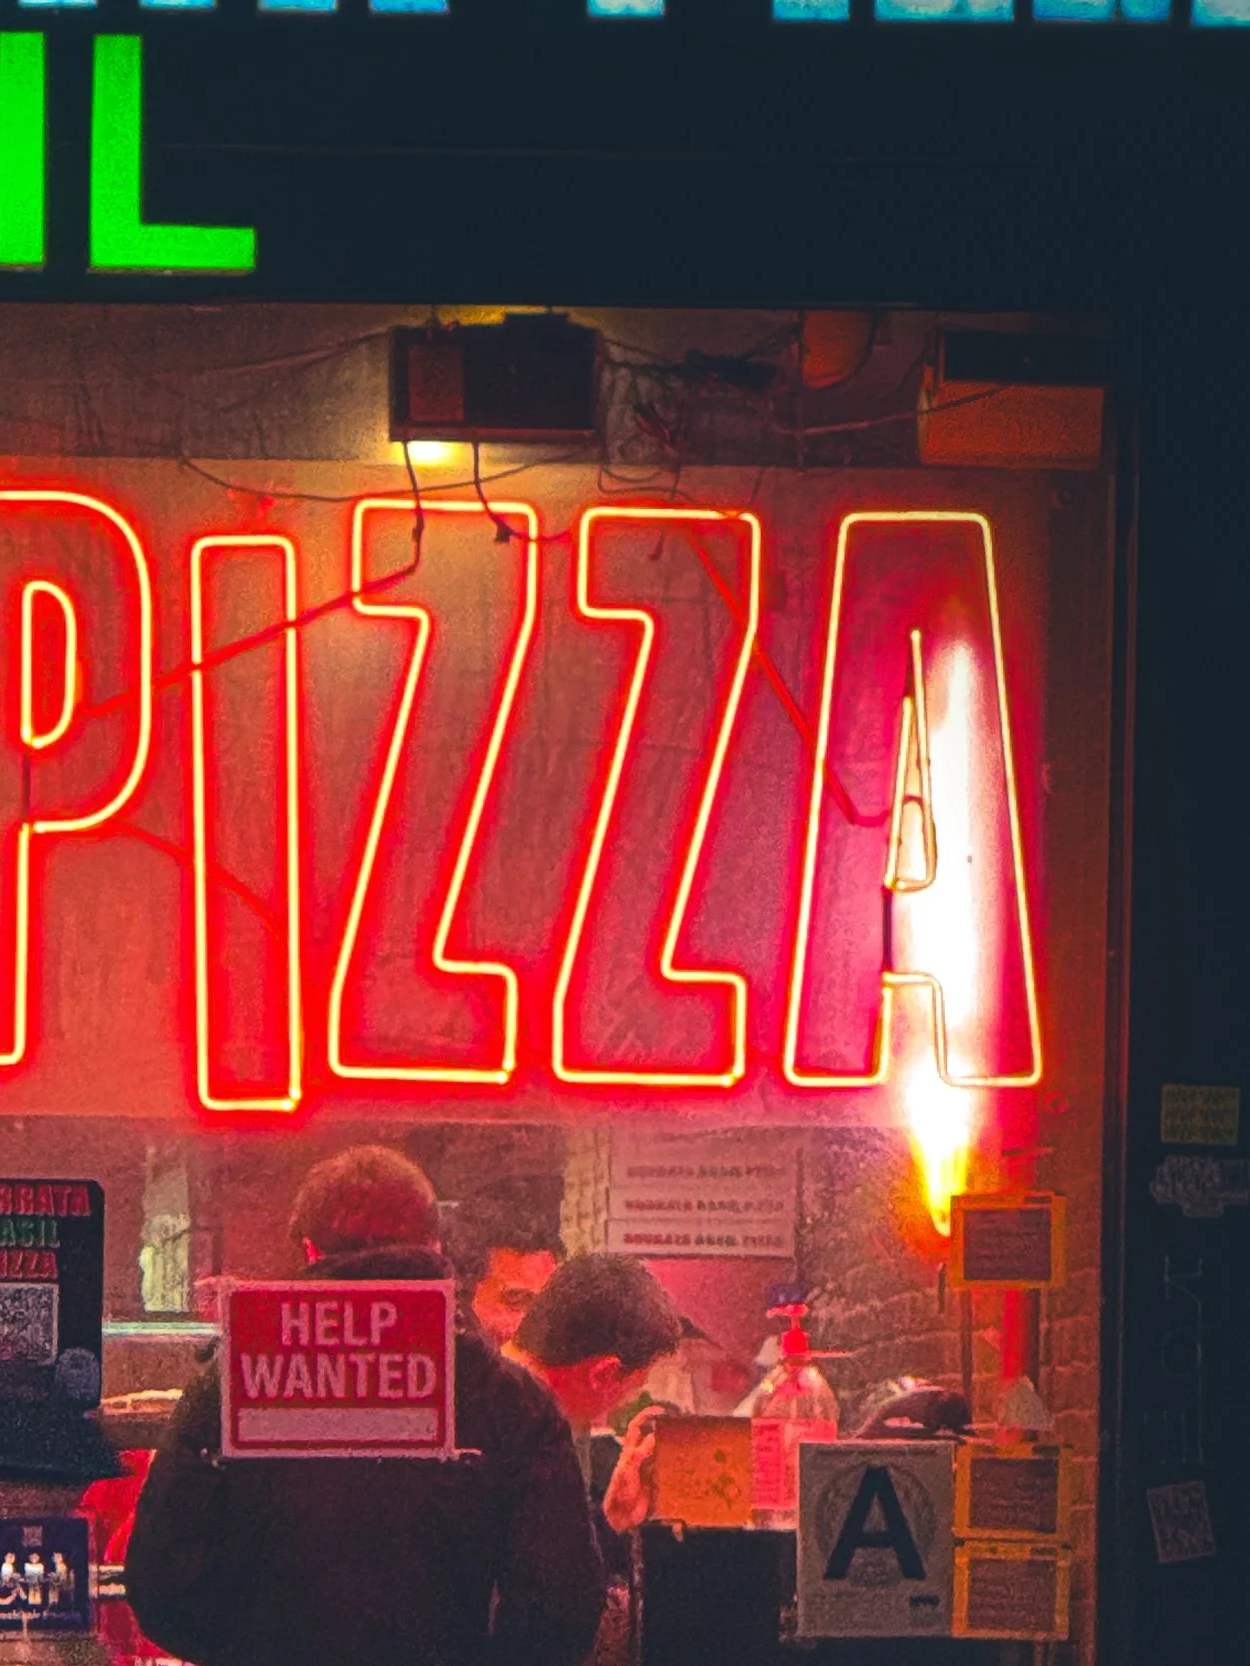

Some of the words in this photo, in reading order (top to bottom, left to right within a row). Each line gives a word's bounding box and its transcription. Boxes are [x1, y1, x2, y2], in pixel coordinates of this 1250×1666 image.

[280, 1299, 398, 1346] HELP
[239, 1352, 437, 1399] WANTED
[823, 1463, 927, 1581] A
